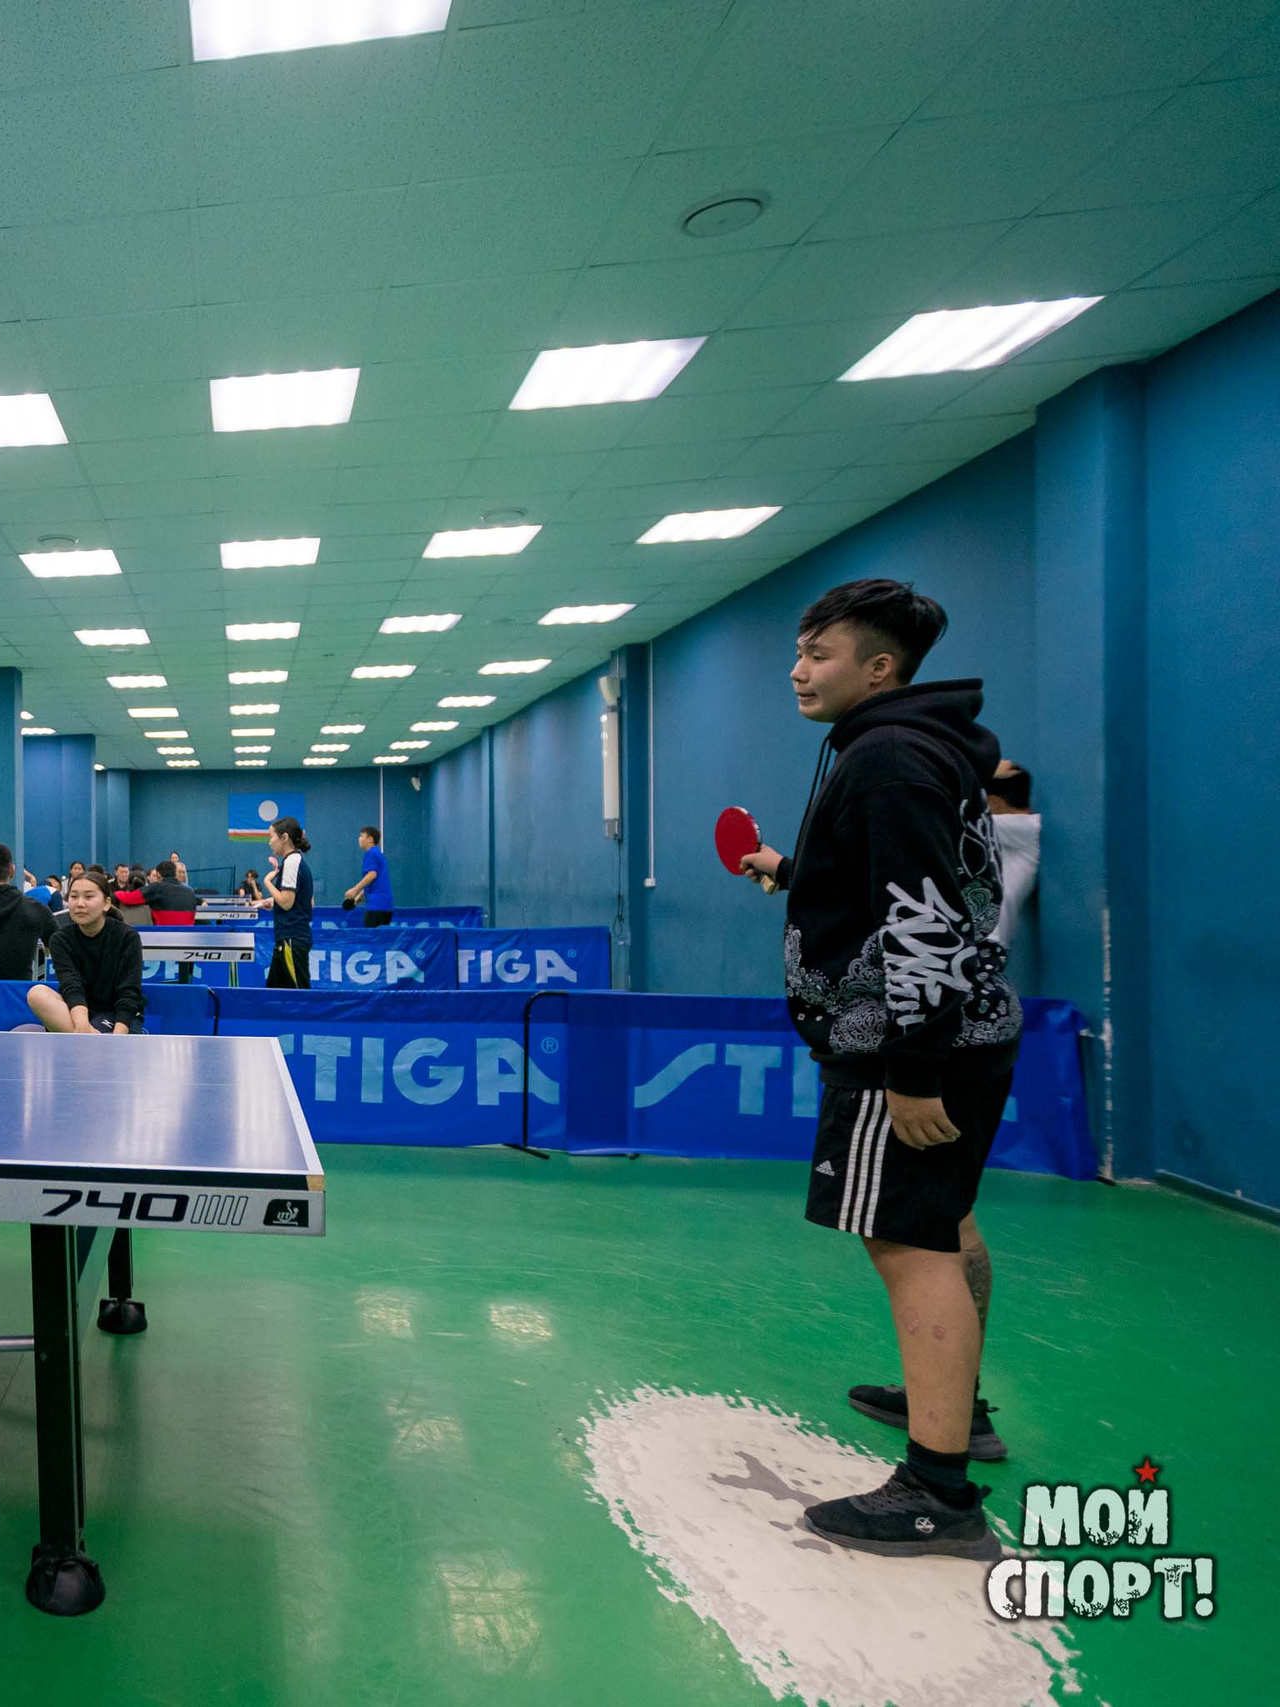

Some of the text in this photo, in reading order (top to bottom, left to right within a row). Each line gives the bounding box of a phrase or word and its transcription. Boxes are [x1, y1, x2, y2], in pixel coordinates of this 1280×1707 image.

[183, 951, 221, 960] 740
[309, 950, 425, 985] TIGA
[41, 1188, 190, 1223] 740
